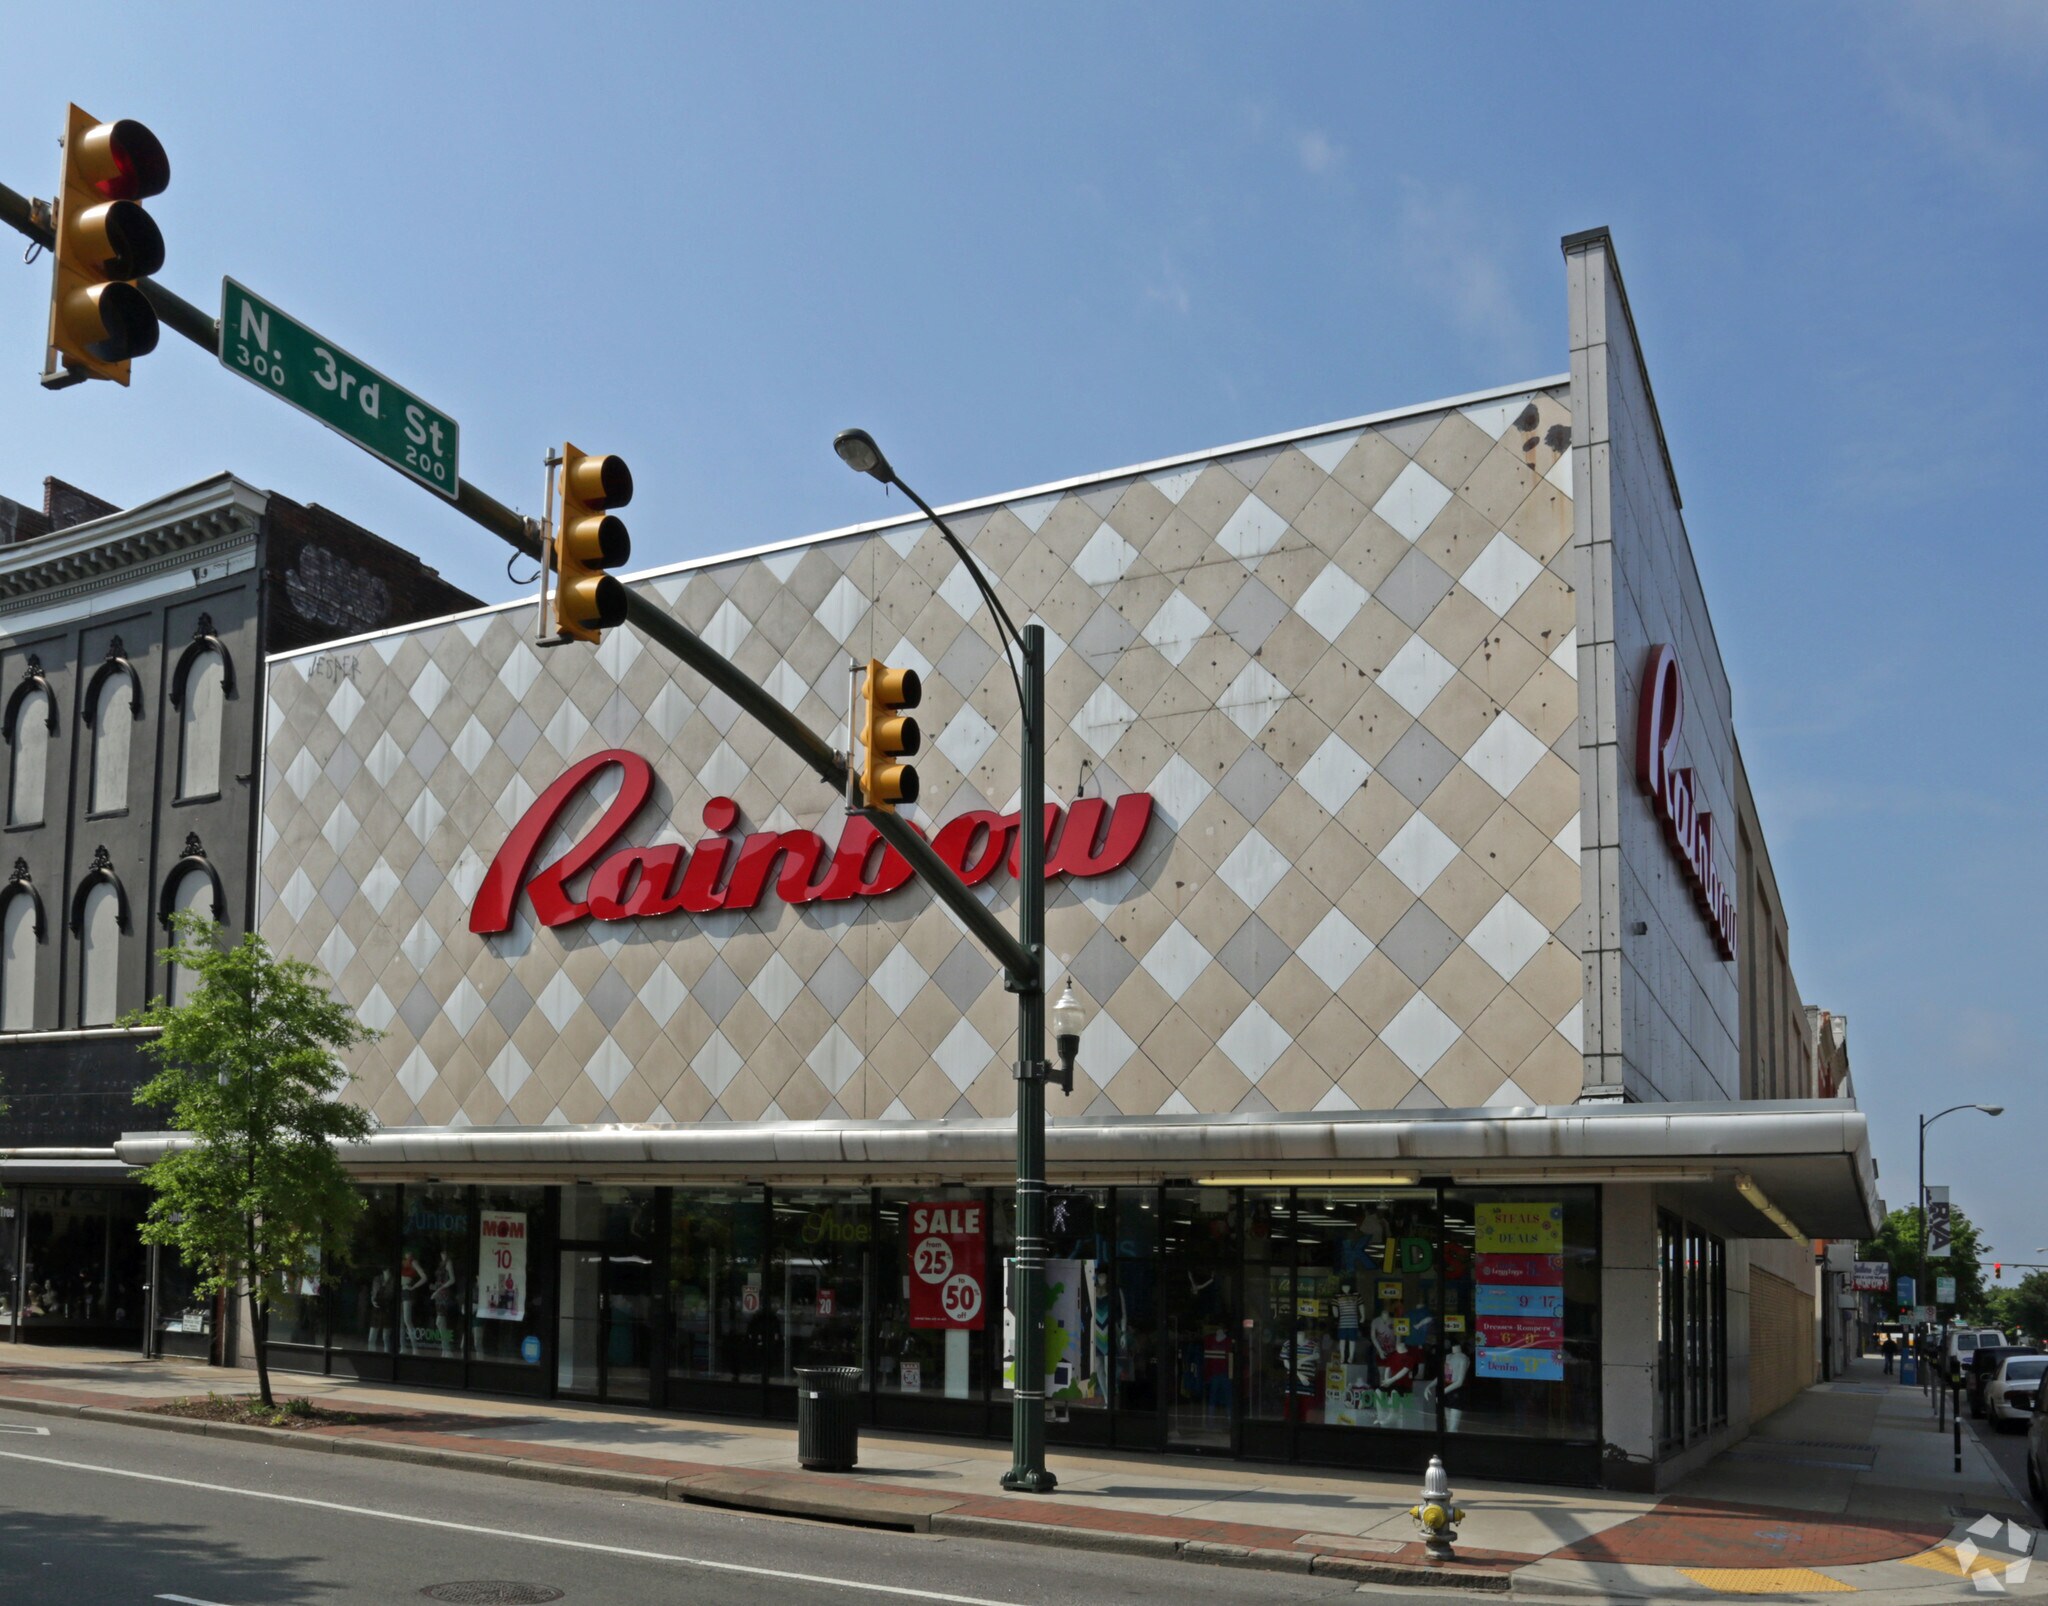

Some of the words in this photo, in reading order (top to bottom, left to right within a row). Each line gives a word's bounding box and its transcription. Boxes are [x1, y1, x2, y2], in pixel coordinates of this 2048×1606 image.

[236, 344, 285, 386] 300
[239, 299, 282, 360] N.
[311, 347, 380, 420] 3rd
[403, 403, 444, 457] St
[404, 445, 446, 481] 200
[468, 748, 1154, 934] Rainbow
[483, 1220, 525, 1238] MOM
[913, 1208, 981, 1234] SALE
[1495, 1213, 1540, 1224] STEALS
[1931, 1202, 1952, 1251] RVA
[1499, 1233, 1538, 1244] DEALS
[1341, 1234, 1470, 1280] KIDS
[1483, 1323, 1513, 1331] Dresses
[1488, 1361, 1519, 1372] Denim
